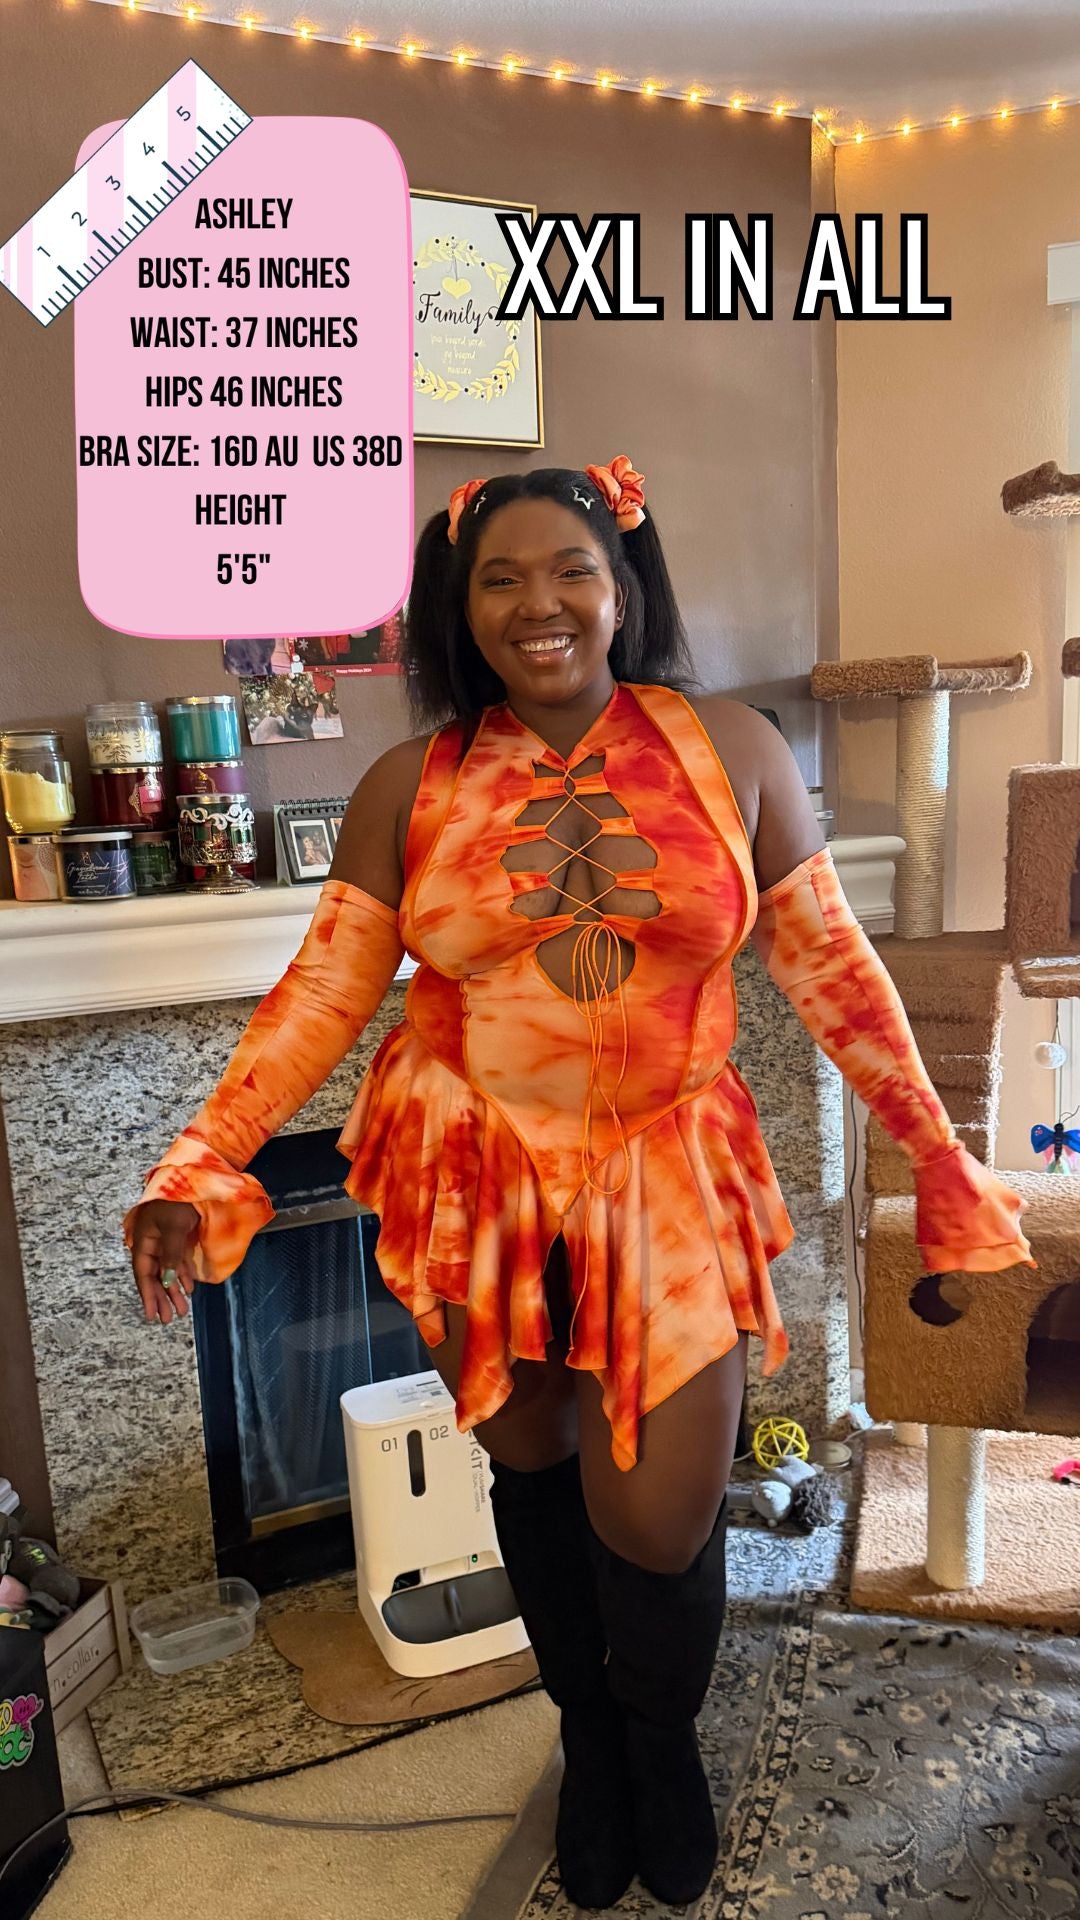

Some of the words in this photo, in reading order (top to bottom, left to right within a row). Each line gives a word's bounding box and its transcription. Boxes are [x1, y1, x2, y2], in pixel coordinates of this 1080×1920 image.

[415, 291, 492, 334] Family
[381, 1437, 399, 1452] 01
[429, 1426, 449, 1441] 02
